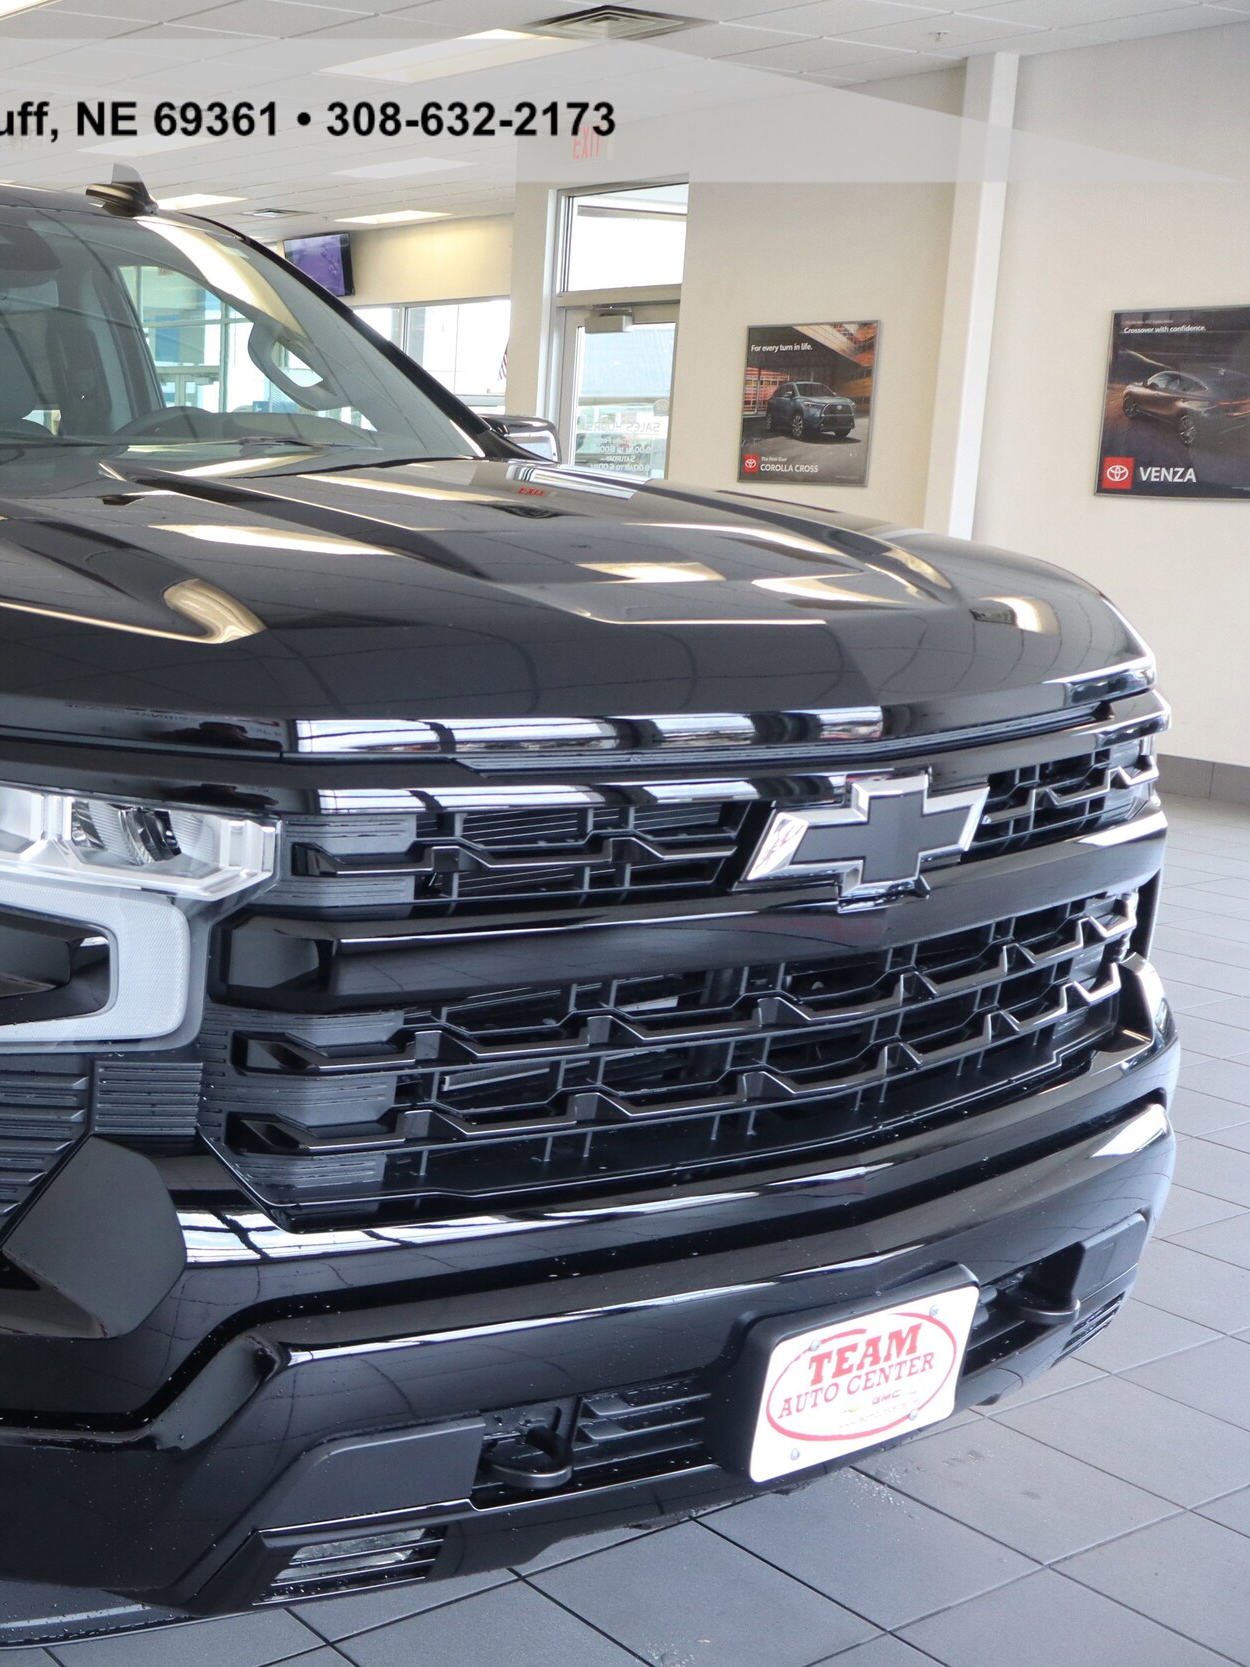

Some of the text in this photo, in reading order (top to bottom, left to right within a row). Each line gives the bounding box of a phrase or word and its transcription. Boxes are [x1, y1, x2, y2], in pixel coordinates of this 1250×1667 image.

[1170, 324, 1207, 332] confidence.
[751, 344, 761, 352] For
[762, 345, 778, 353] every
[801, 342, 813, 351] life.
[760, 463, 819, 473] COROLLA CROSS
[1139, 466, 1197, 483] VENZA
[808, 1323, 922, 1386] TEAM
[777, 1382, 840, 1419] AUTO
[846, 1351, 935, 1396] CENTER
[871, 1389, 901, 1405] GMC
